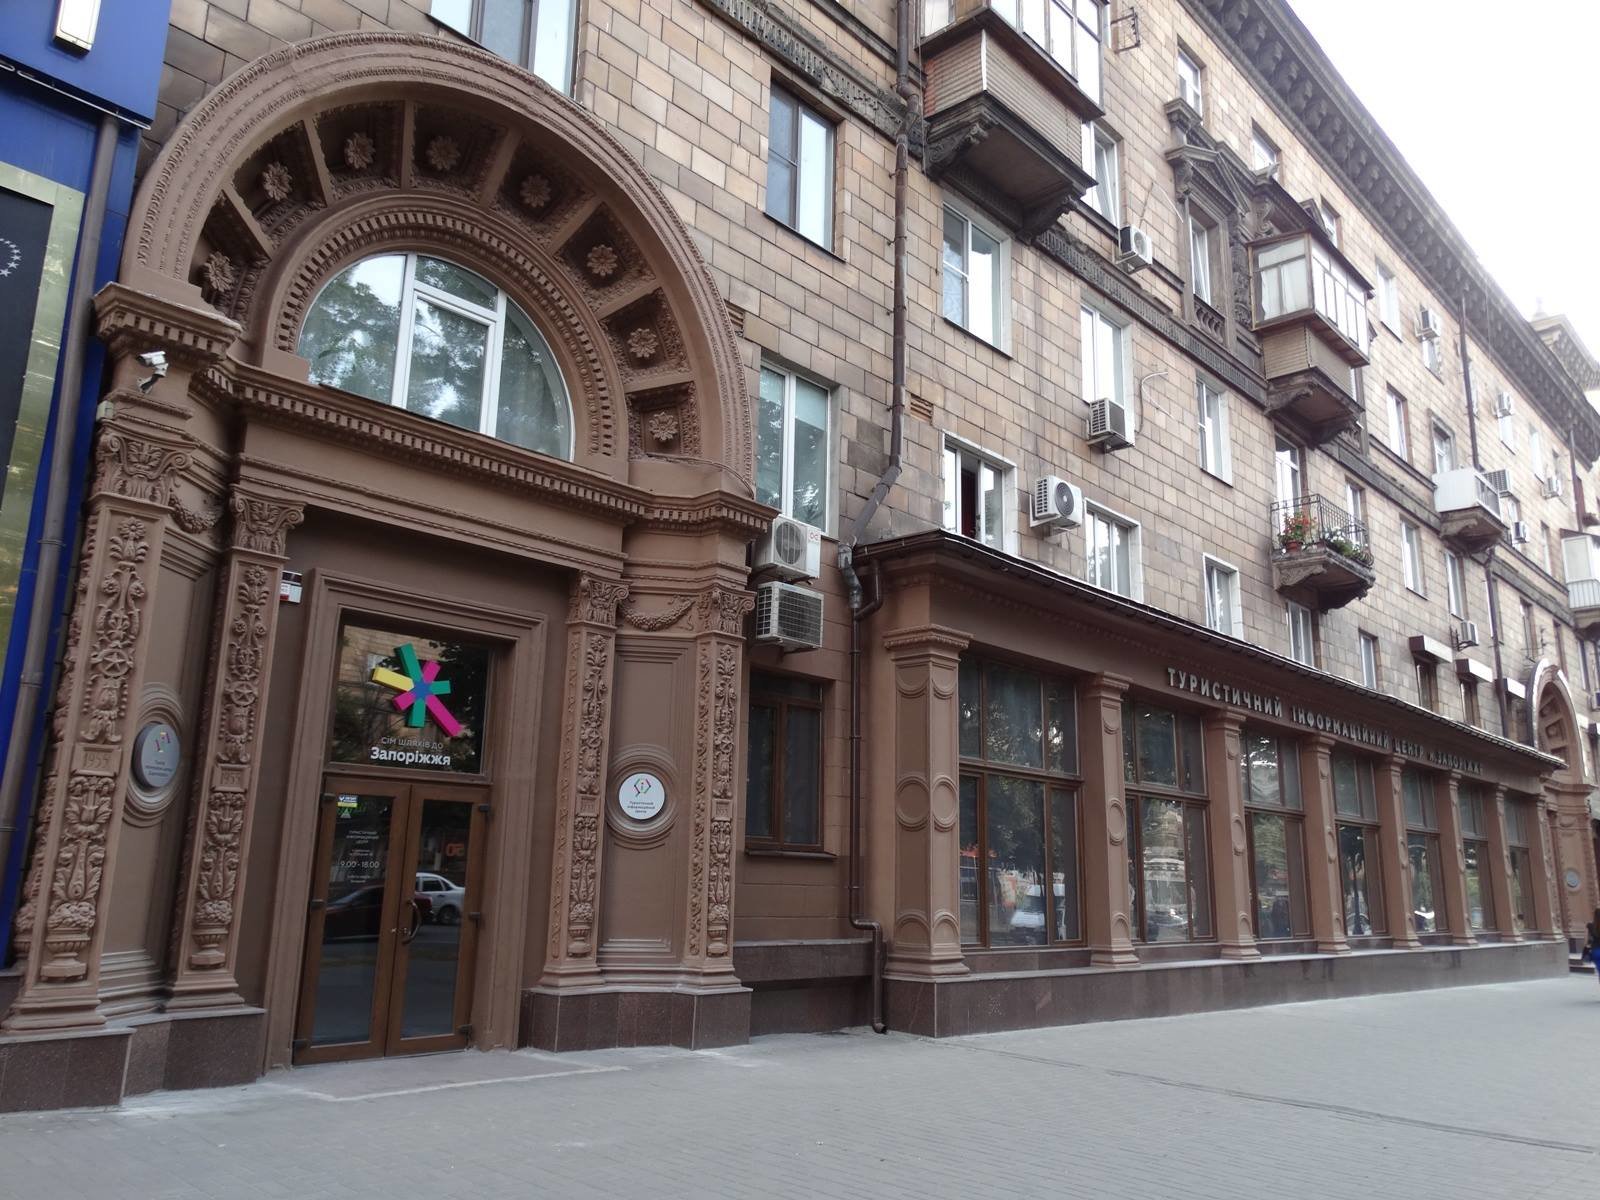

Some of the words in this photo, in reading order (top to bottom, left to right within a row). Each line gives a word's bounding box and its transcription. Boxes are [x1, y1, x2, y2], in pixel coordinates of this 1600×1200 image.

[1167, 667, 1283, 718] ТУРИСТИЧНИЙ
[1291, 705, 1390, 749] ІНФОРМАЦІЙНИЙ
[1394, 738, 1424, 758] ЦЕНТР
[370, 746, 451, 766] Запоріжжя
